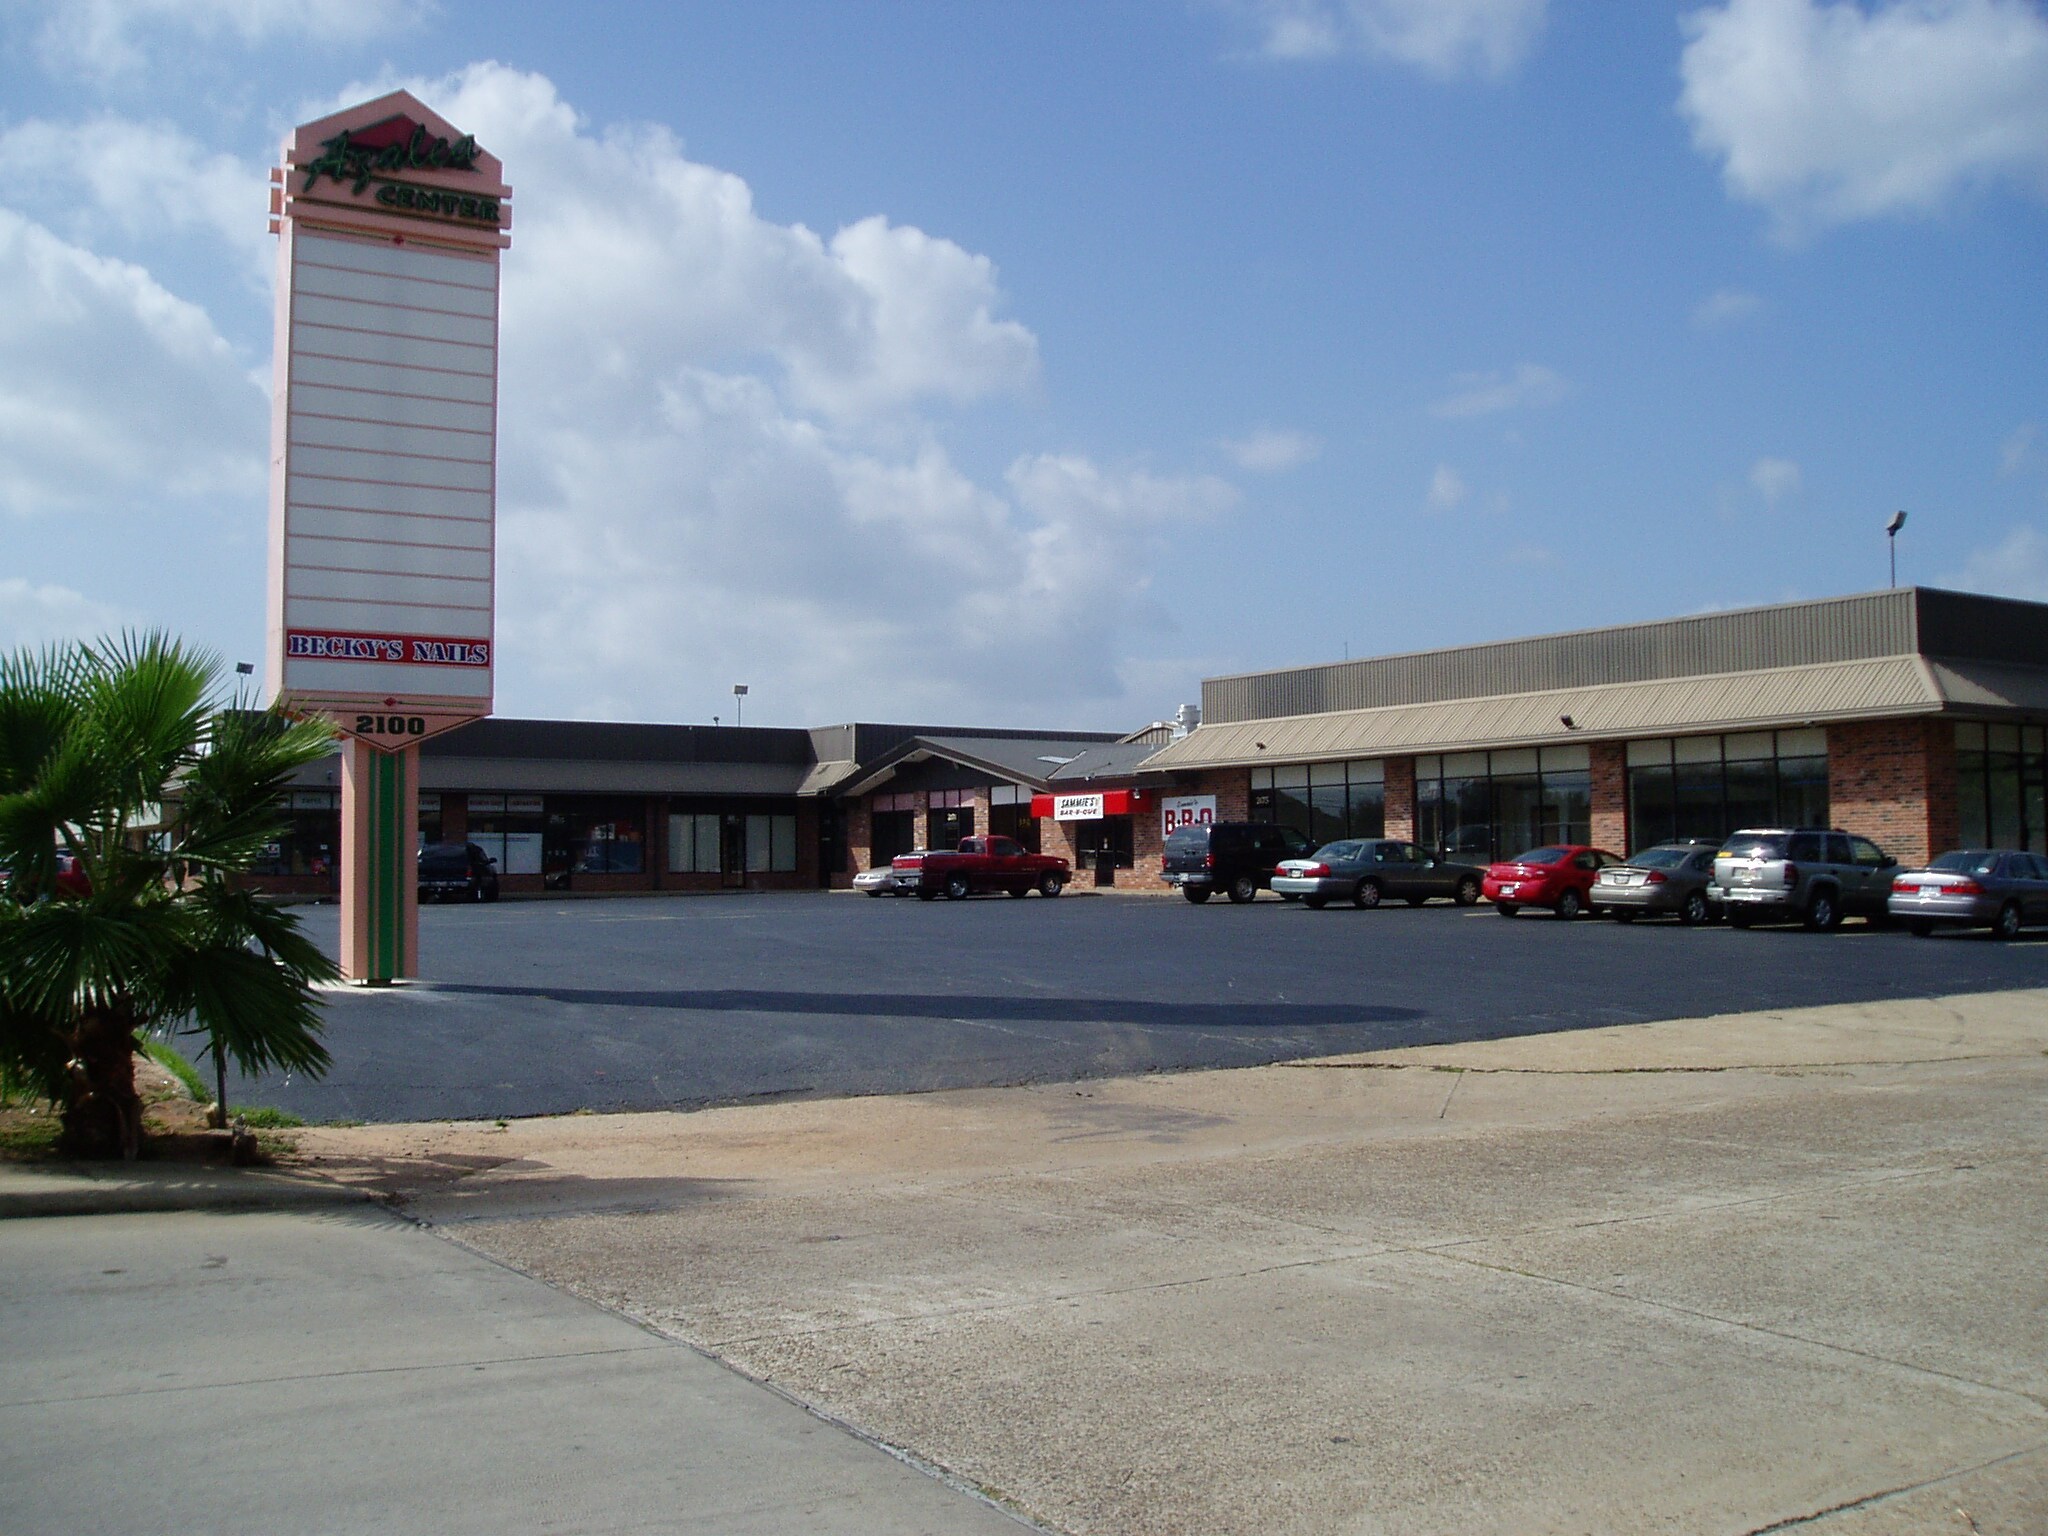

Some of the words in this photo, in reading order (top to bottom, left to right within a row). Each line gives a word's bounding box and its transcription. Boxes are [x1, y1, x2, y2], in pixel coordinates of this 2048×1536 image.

[303, 123, 481, 195] Azalea
[375, 185, 500, 221] CENTER
[289, 635, 402, 660] BECKY'S
[413, 641, 487, 664] NAILS
[356, 715, 425, 735] 2100
